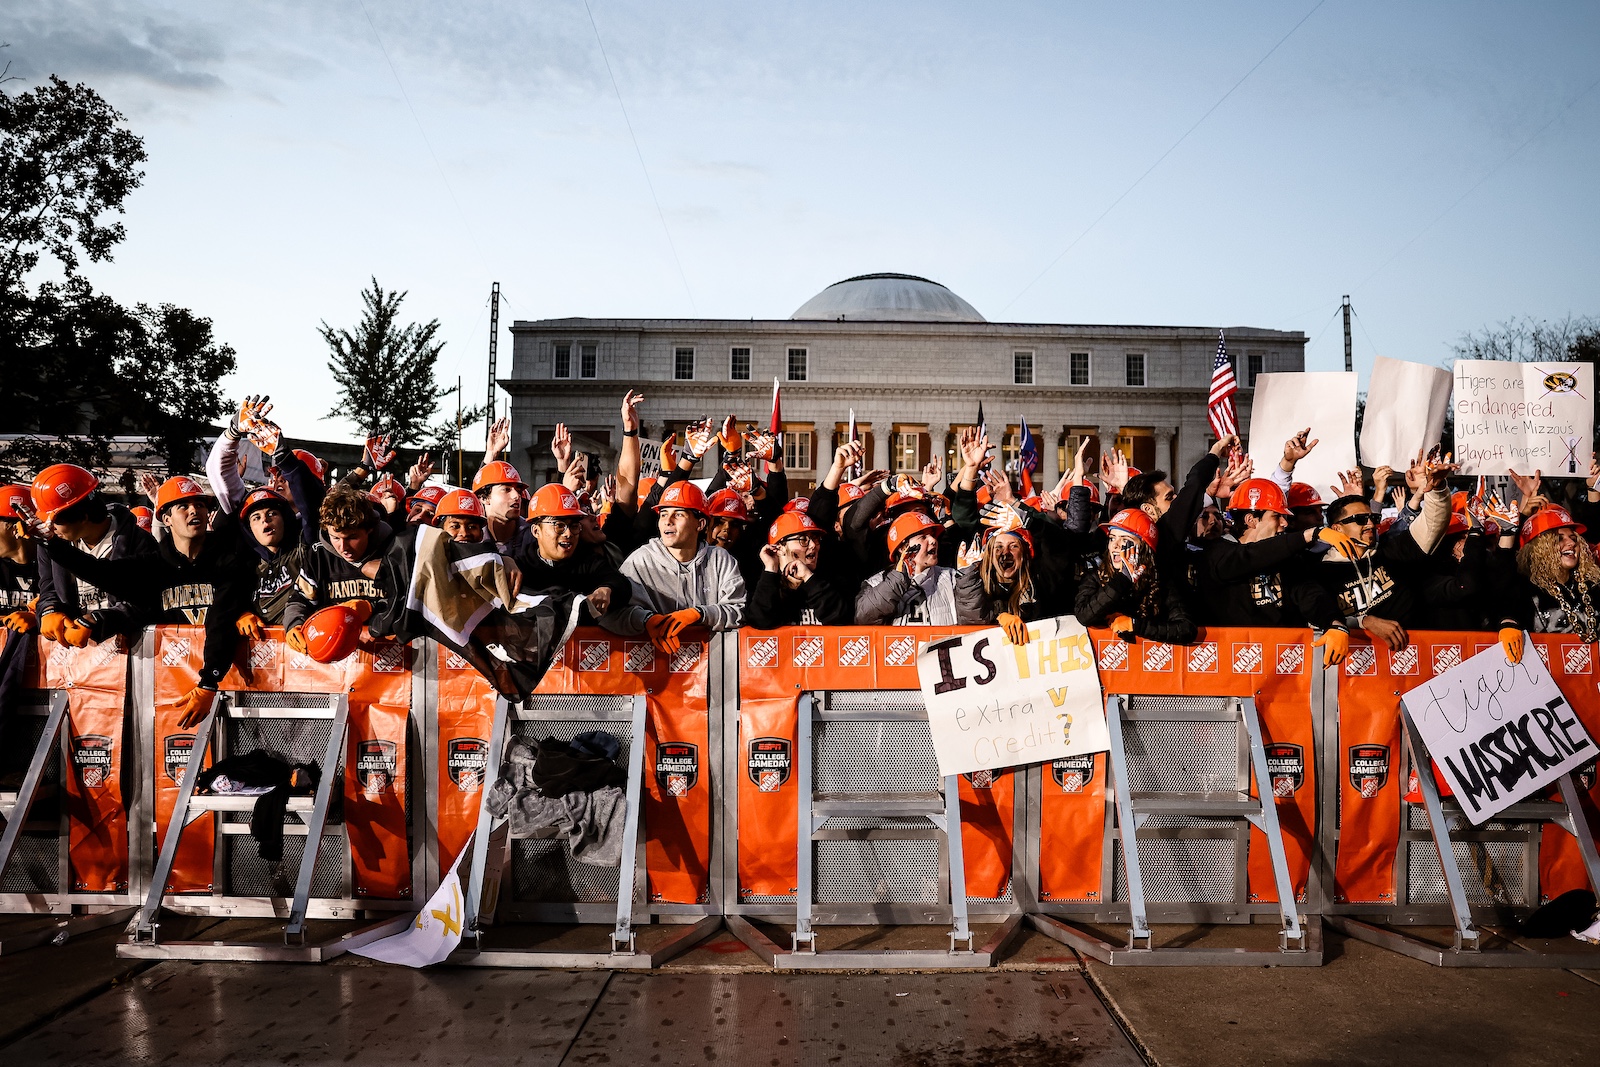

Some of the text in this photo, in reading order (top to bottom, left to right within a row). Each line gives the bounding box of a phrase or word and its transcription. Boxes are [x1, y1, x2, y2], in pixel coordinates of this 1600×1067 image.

[1502, 379, 1525, 390] are
[1495, 419, 1518, 434] like
[1523, 420, 1574, 435] Mizzou's
[1457, 440, 1552, 468] Playoff hopes!
[162, 637, 191, 666] HOME
[249, 639, 277, 668] HOME
[582, 644, 595, 656] THE
[628, 645, 641, 657] THE
[747, 636, 778, 667] HOME
[750, 640, 764, 653] THE
[793, 636, 824, 667] HOME
[796, 639, 810, 653] THE
[838, 636, 869, 667] HOME
[841, 639, 855, 652] THE
[884, 635, 915, 666] HOME
[887, 639, 901, 652] THE
[1101, 643, 1114, 655] THE
[1146, 644, 1158, 656] THE
[1190, 645, 1202, 657] THE
[1235, 646, 1247, 658] THE
[1279, 647, 1291, 659] THE
[1565, 648, 1578, 659] THE
[579, 641, 610, 670] HOME
[624, 642, 655, 671] HOME
[759, 649, 777, 667] DEPOT
[805, 649, 823, 667] DEPOT
[851, 648, 869, 666] DEPOT
[897, 648, 915, 666] DEPOT
[926, 629, 1093, 695] IS THIS
[1098, 640, 1128, 670] HOME
[1110, 653, 1128, 670] DEPOT
[1143, 642, 1173, 671] HOME
[1155, 654, 1173, 671] DEPOT
[1187, 642, 1218, 672] HOME
[1200, 655, 1218, 672] DEPOT
[1232, 643, 1262, 673] HOME
[1276, 644, 1304, 673] HOME
[1346, 645, 1375, 675] HOME
[1390, 645, 1418, 675] HOME
[1432, 645, 1461, 674] HOME
[1564, 644, 1591, 673] HOME
[1244, 656, 1262, 673] DEPOT
[1286, 656, 1304, 673] DEPOT
[1575, 655, 1591, 674] DEPOT
[1424, 657, 1539, 734] tiger
[955, 699, 1034, 732] extra
[665, 747, 689, 755] ESPN
[1444, 695, 1591, 812] MASSACRE
[357, 762, 396, 770] GAMEDAY
[448, 759, 487, 767] GAMEDAY
[656, 764, 697, 772] GAMEDAY
[748, 760, 790, 768] GAMEDAY
[1053, 761, 1093, 769] GAMEDAY
[1268, 765, 1303, 773] AMEDAY
[1350, 765, 1388, 774] GAMEDAY
